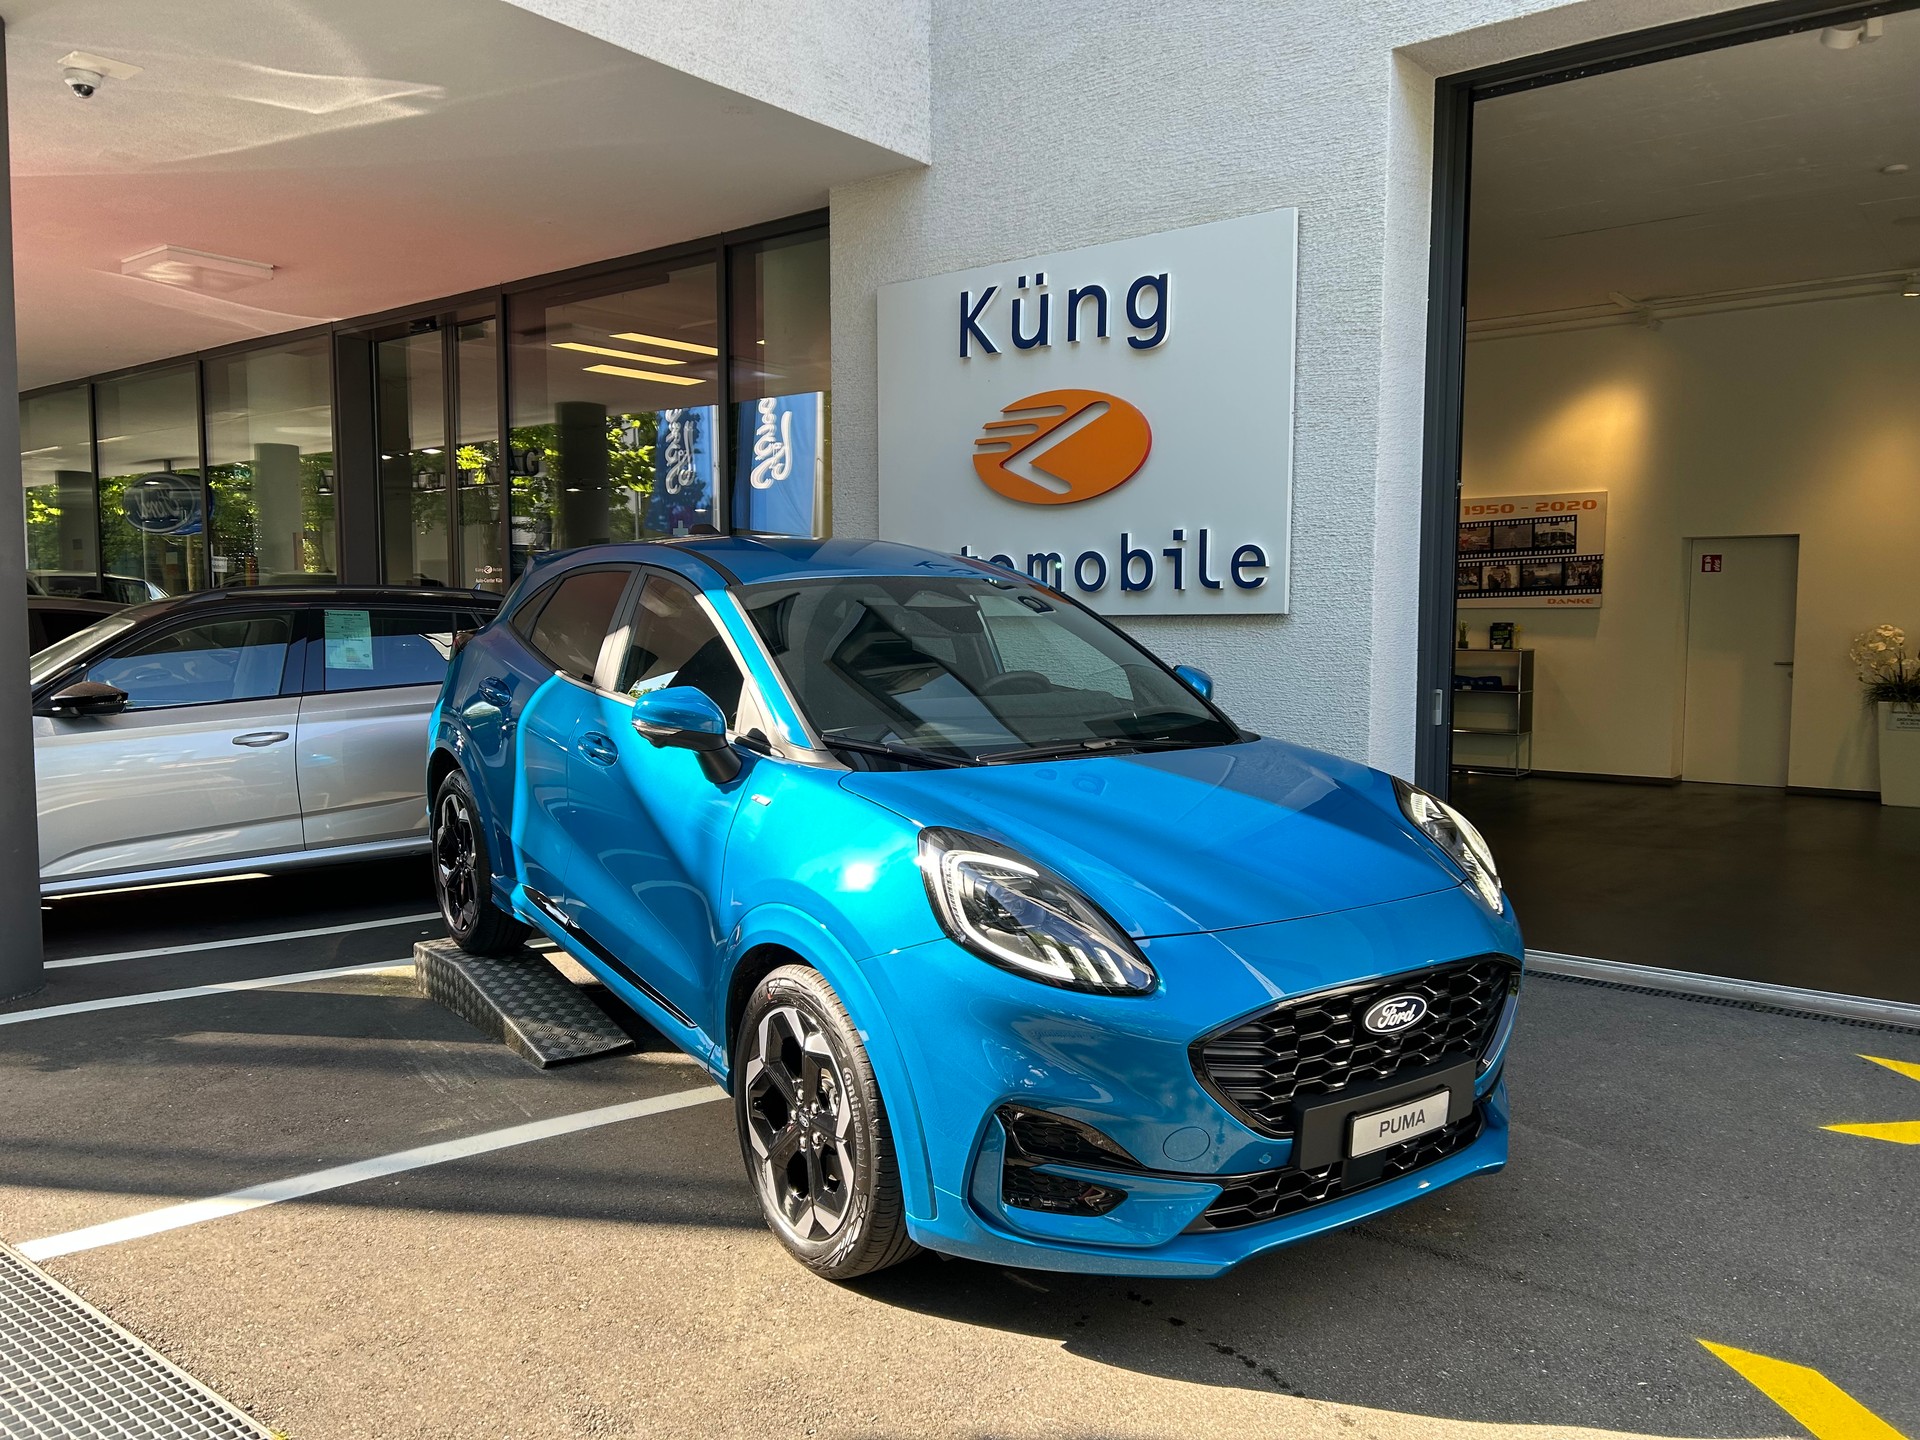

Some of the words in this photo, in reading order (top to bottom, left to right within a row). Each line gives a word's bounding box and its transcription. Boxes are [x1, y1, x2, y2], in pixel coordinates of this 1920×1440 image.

[959, 272, 1170, 358] Küng
[1463, 503, 1515, 516] 1950
[1535, 499, 1598, 513] 2020
[960, 528, 1270, 593] mobile
[1547, 597, 1594, 605] DANKE
[1377, 1000, 1416, 1029] Ford
[842, 1066, 867, 1168] Continental
[1378, 1108, 1426, 1138] PUMA
